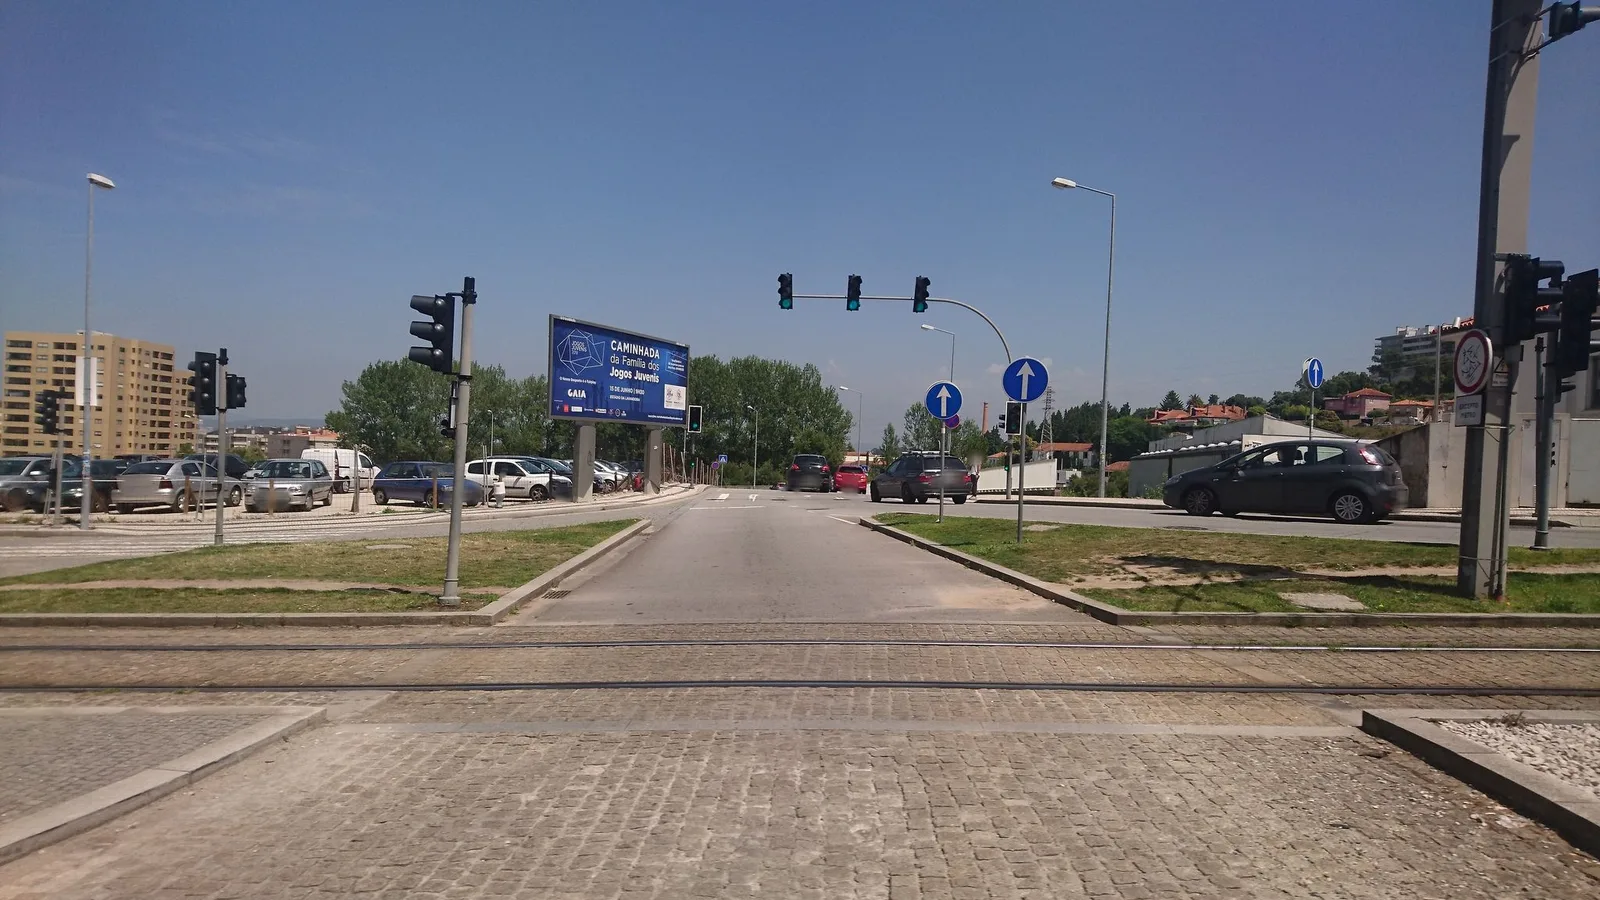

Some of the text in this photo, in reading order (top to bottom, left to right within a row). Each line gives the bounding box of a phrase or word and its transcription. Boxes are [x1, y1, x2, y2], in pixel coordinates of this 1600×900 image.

[611, 340, 660, 359] CAMINHADA
[611, 354, 619, 364] da
[622, 356, 645, 368] Família
[648, 361, 659, 371] dos
[610, 367, 660, 383] Jogos Juvenis
[567, 389, 587, 398] GAIA
